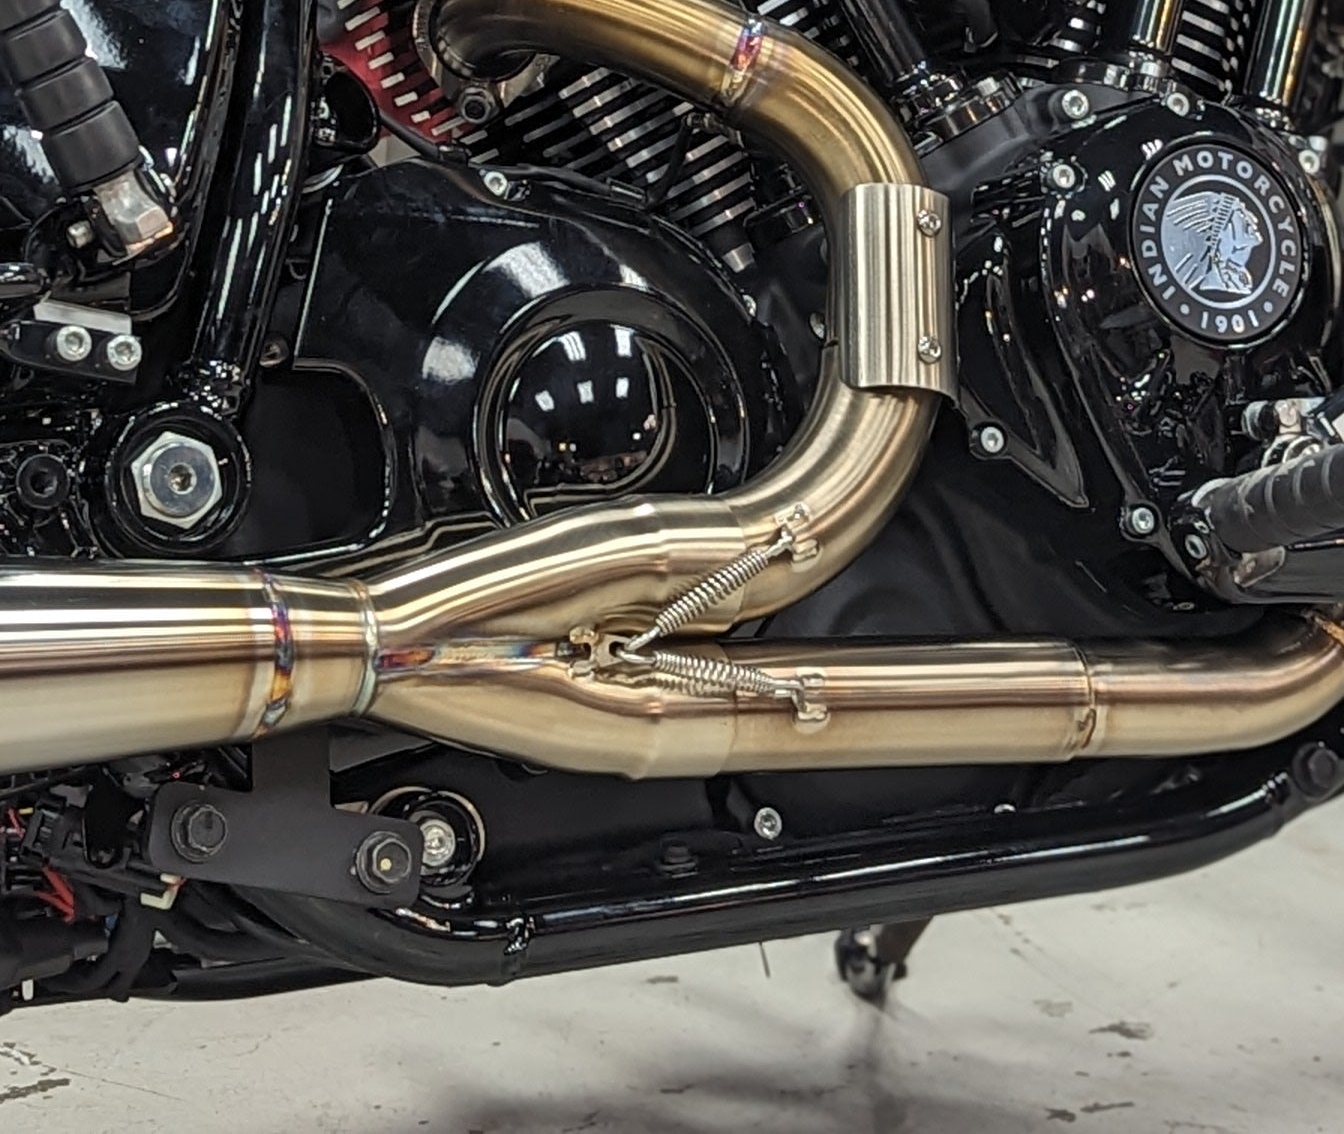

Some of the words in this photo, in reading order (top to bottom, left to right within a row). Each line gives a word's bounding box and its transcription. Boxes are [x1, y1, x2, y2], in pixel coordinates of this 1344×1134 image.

[1140, 175, 1176, 300] INDIAN
[1172, 151, 1296, 298] MOTORCYCLE
[1201, 310, 1259, 333] 1901
